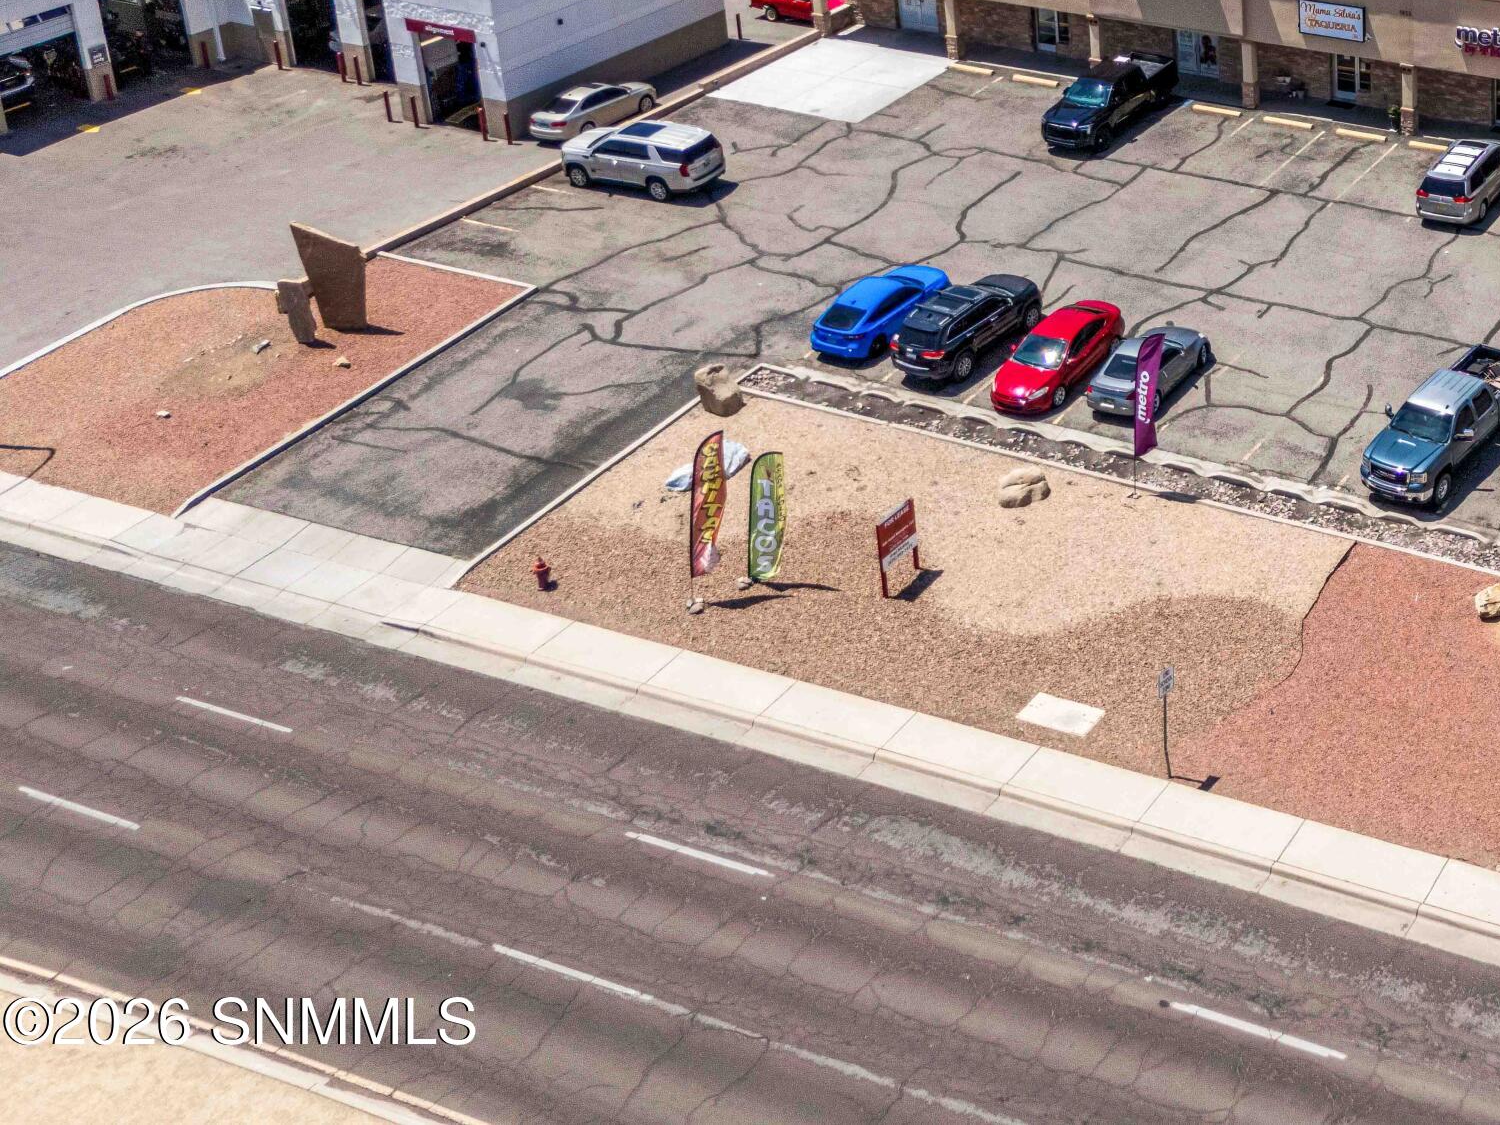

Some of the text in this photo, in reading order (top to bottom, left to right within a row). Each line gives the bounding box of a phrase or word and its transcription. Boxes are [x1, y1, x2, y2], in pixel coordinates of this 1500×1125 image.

[1300, 2, 1331, 16] Mama
[1138, 370, 1151, 424] metro
[700, 443, 724, 543] CARNITAS
[755, 479, 778, 572] TACOS
